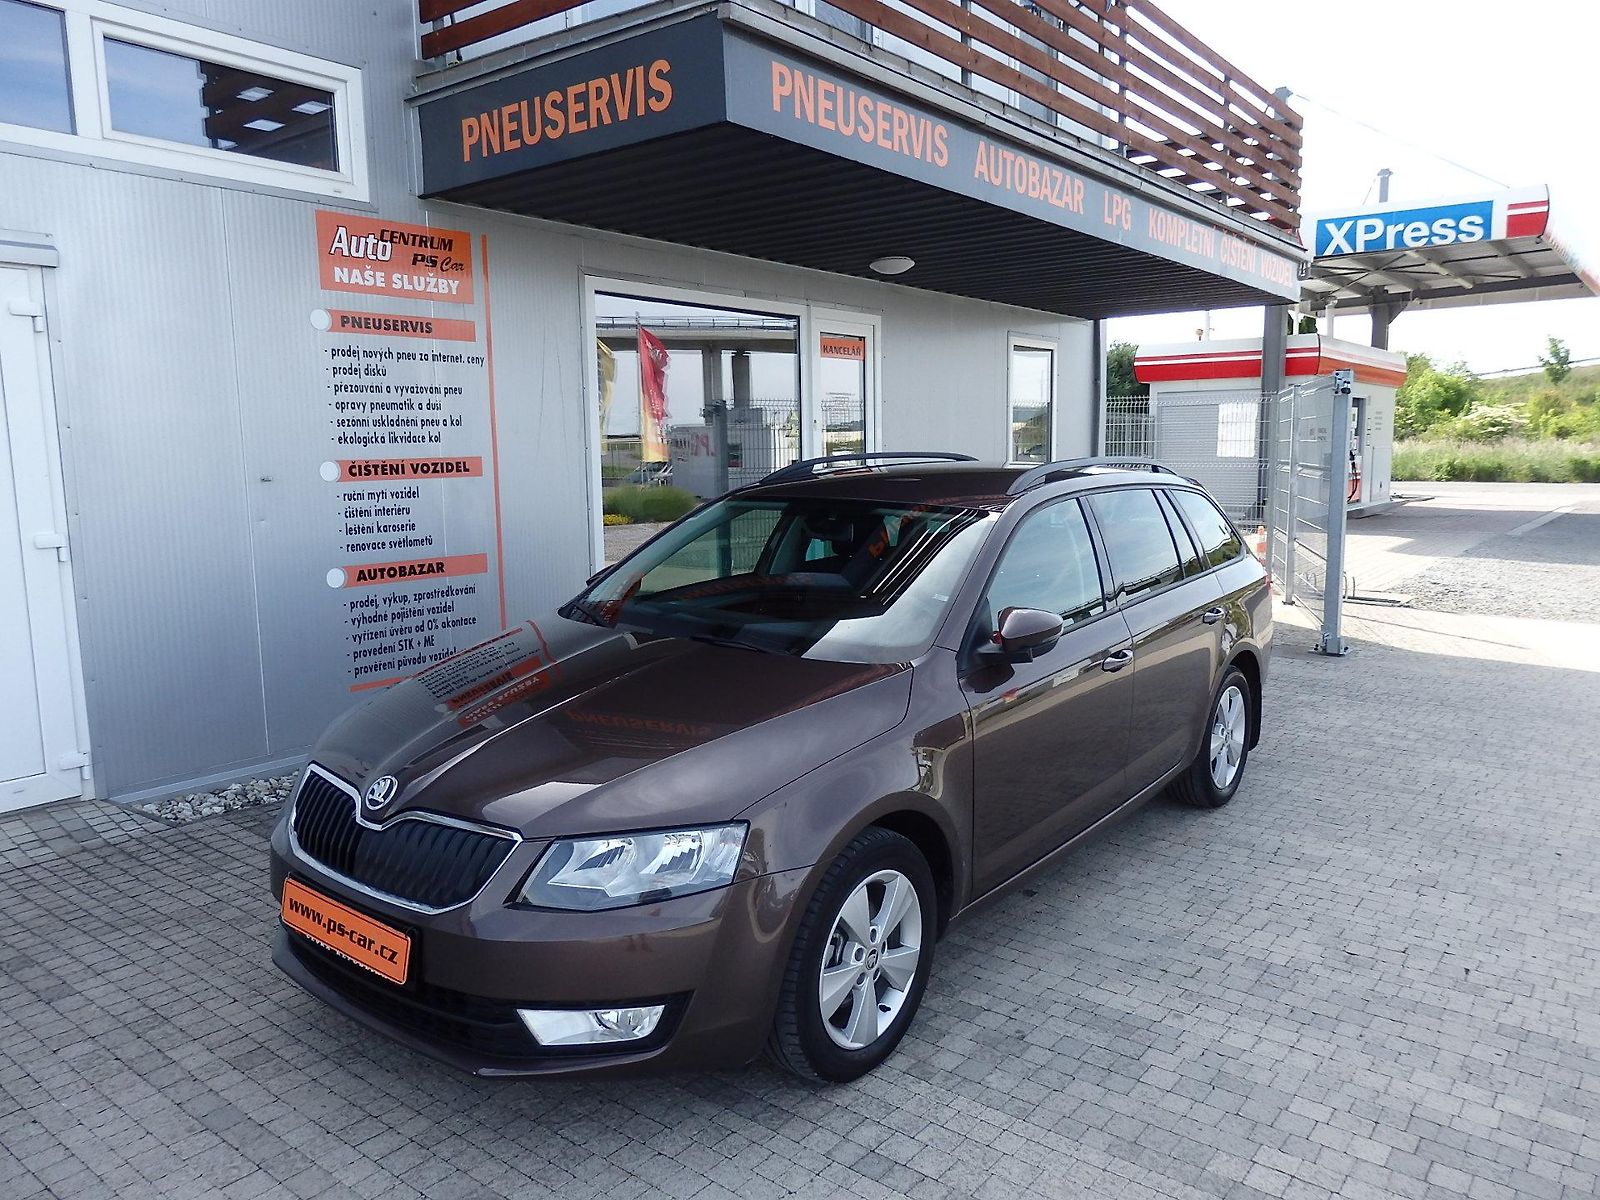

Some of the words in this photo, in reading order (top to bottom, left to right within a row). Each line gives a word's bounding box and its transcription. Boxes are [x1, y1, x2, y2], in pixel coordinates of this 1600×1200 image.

[461, 59, 673, 163] PNEUSERVIS
[771, 61, 949, 168] PNEUSERVIS
[974, 140, 1085, 215] AUTOBAZAR
[1103, 190, 1132, 231] LPG
[1149, 207, 1215, 259] KOMPLETNÍ
[1260, 252, 1294, 288] VOZIDEL
[329, 225, 393, 262] Auto
[380, 229, 454, 252] CENTRUM
[1323, 215, 1485, 257] XPress
[411, 253, 439, 268] PS
[334, 265, 386, 288] NAŠE
[392, 273, 460, 295] SLUŽBY
[340, 315, 433, 334] PNEUSERVIS
[331, 345, 360, 361] prodej
[362, 347, 394, 362] nových
[396, 352, 417, 363] pneu
[419, 352, 429, 362] za
[431, 349, 465, 364] internet.
[467, 355, 485, 367] ceny
[332, 364, 361, 379] prodej
[364, 364, 387, 377] disků
[334, 382, 383, 396] přezouvání
[385, 386, 391, 394] a
[444, 386, 463, 398] pneu
[335, 401, 367, 413] opravy
[370, 399, 415, 413] pneumatik
[417, 402, 423, 411] a
[336, 416, 370, 428] sezónní
[420, 418, 440, 429] pneu
[442, 418, 448, 427] a
[450, 415, 463, 427] kol
[337, 432, 386, 448] ekologická
[388, 432, 426, 445] likvidace
[428, 431, 441, 444] kol
[348, 459, 406, 477] ČIŠTĚNÍ
[410, 461, 470, 475] VOZIDEL
[343, 489, 365, 502] ruční
[367, 488, 387, 503] mytí
[390, 486, 420, 499] vozidel
[344, 506, 372, 519] čištění
[374, 504, 411, 517] interiéru
[345, 522, 374, 536] leštění
[376, 520, 416, 534] karoserie
[346, 540, 386, 553] renovace
[388, 535, 433, 551] světlometů
[356, 561, 445, 583] AUTOBAZAR
[350, 594, 380, 612] prodej,
[382, 591, 411, 608] výkup,
[413, 583, 476, 604] zprostředkování
[351, 610, 388, 628] výhodné
[391, 605, 425, 623] pojištění
[427, 601, 455, 615] vozidel
[352, 626, 387, 645] vyřízení
[389, 622, 412, 637] úvěru
[414, 621, 425, 633] od
[427, 618, 439, 631] 0%
[441, 616, 477, 629] akontace
[353, 641, 396, 662] provedení
[398, 638, 415, 652] STK
[423, 634, 435, 648] ME
[354, 657, 395, 678] prověření
[397, 653, 427, 671] původu
[289, 896, 399, 966] www.ps-car.cz
